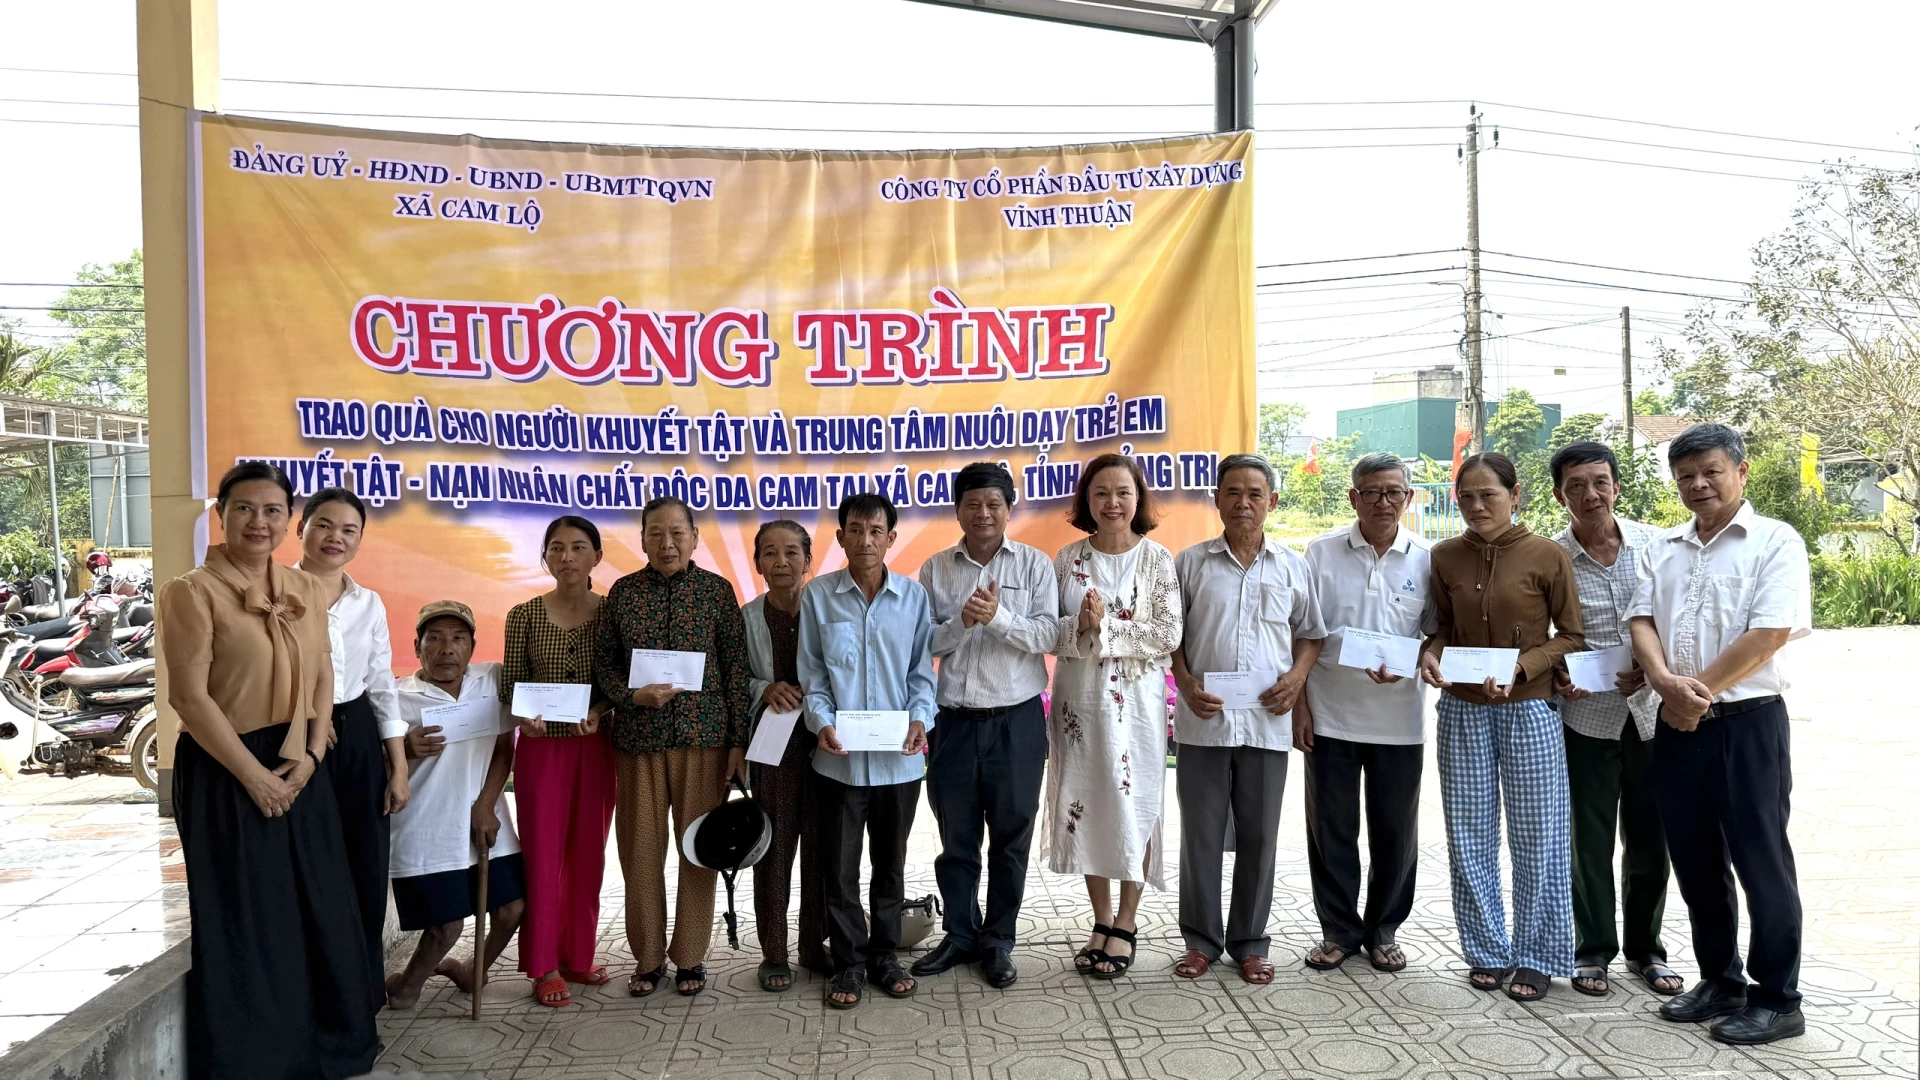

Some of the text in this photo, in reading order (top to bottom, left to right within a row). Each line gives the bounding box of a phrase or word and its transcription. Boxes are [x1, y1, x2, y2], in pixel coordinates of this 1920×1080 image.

[233, 145, 305, 175] ĐẢNG
[312, 151, 349, 177] UỶ
[368, 160, 449, 184] HĐND
[469, 166, 543, 190] UBND
[565, 173, 713, 203] UBMTTQVN
[881, 160, 1243, 201] CÔNG TY CỔ PHẦN ĐẦU TƯ XÂY DỰNG
[396, 193, 541, 231] XÃ CAM LỘ
[1003, 199, 1133, 229] VĨNH THUẬN
[354, 290, 1108, 383] CHƯƠNG TRÌNH
[298, 395, 1163, 459] TRAO QUÀ CHO NGƯỜI KHUYẾT TẬT VÀ TRUNG TÂM NUÔI DẠY TRẺ EM
[238, 450, 345, 494] UYẾT
[352, 455, 400, 504] TẬT
[430, 464, 490, 506] NẠN
[498, 464, 569, 505] NHÂN
[577, 463, 645, 507] CHẤT
[715, 476, 751, 508] DA
[758, 476, 818, 507] CAM
[874, 467, 909, 505] XÃ
[1024, 455, 1079, 498] TỈNH
